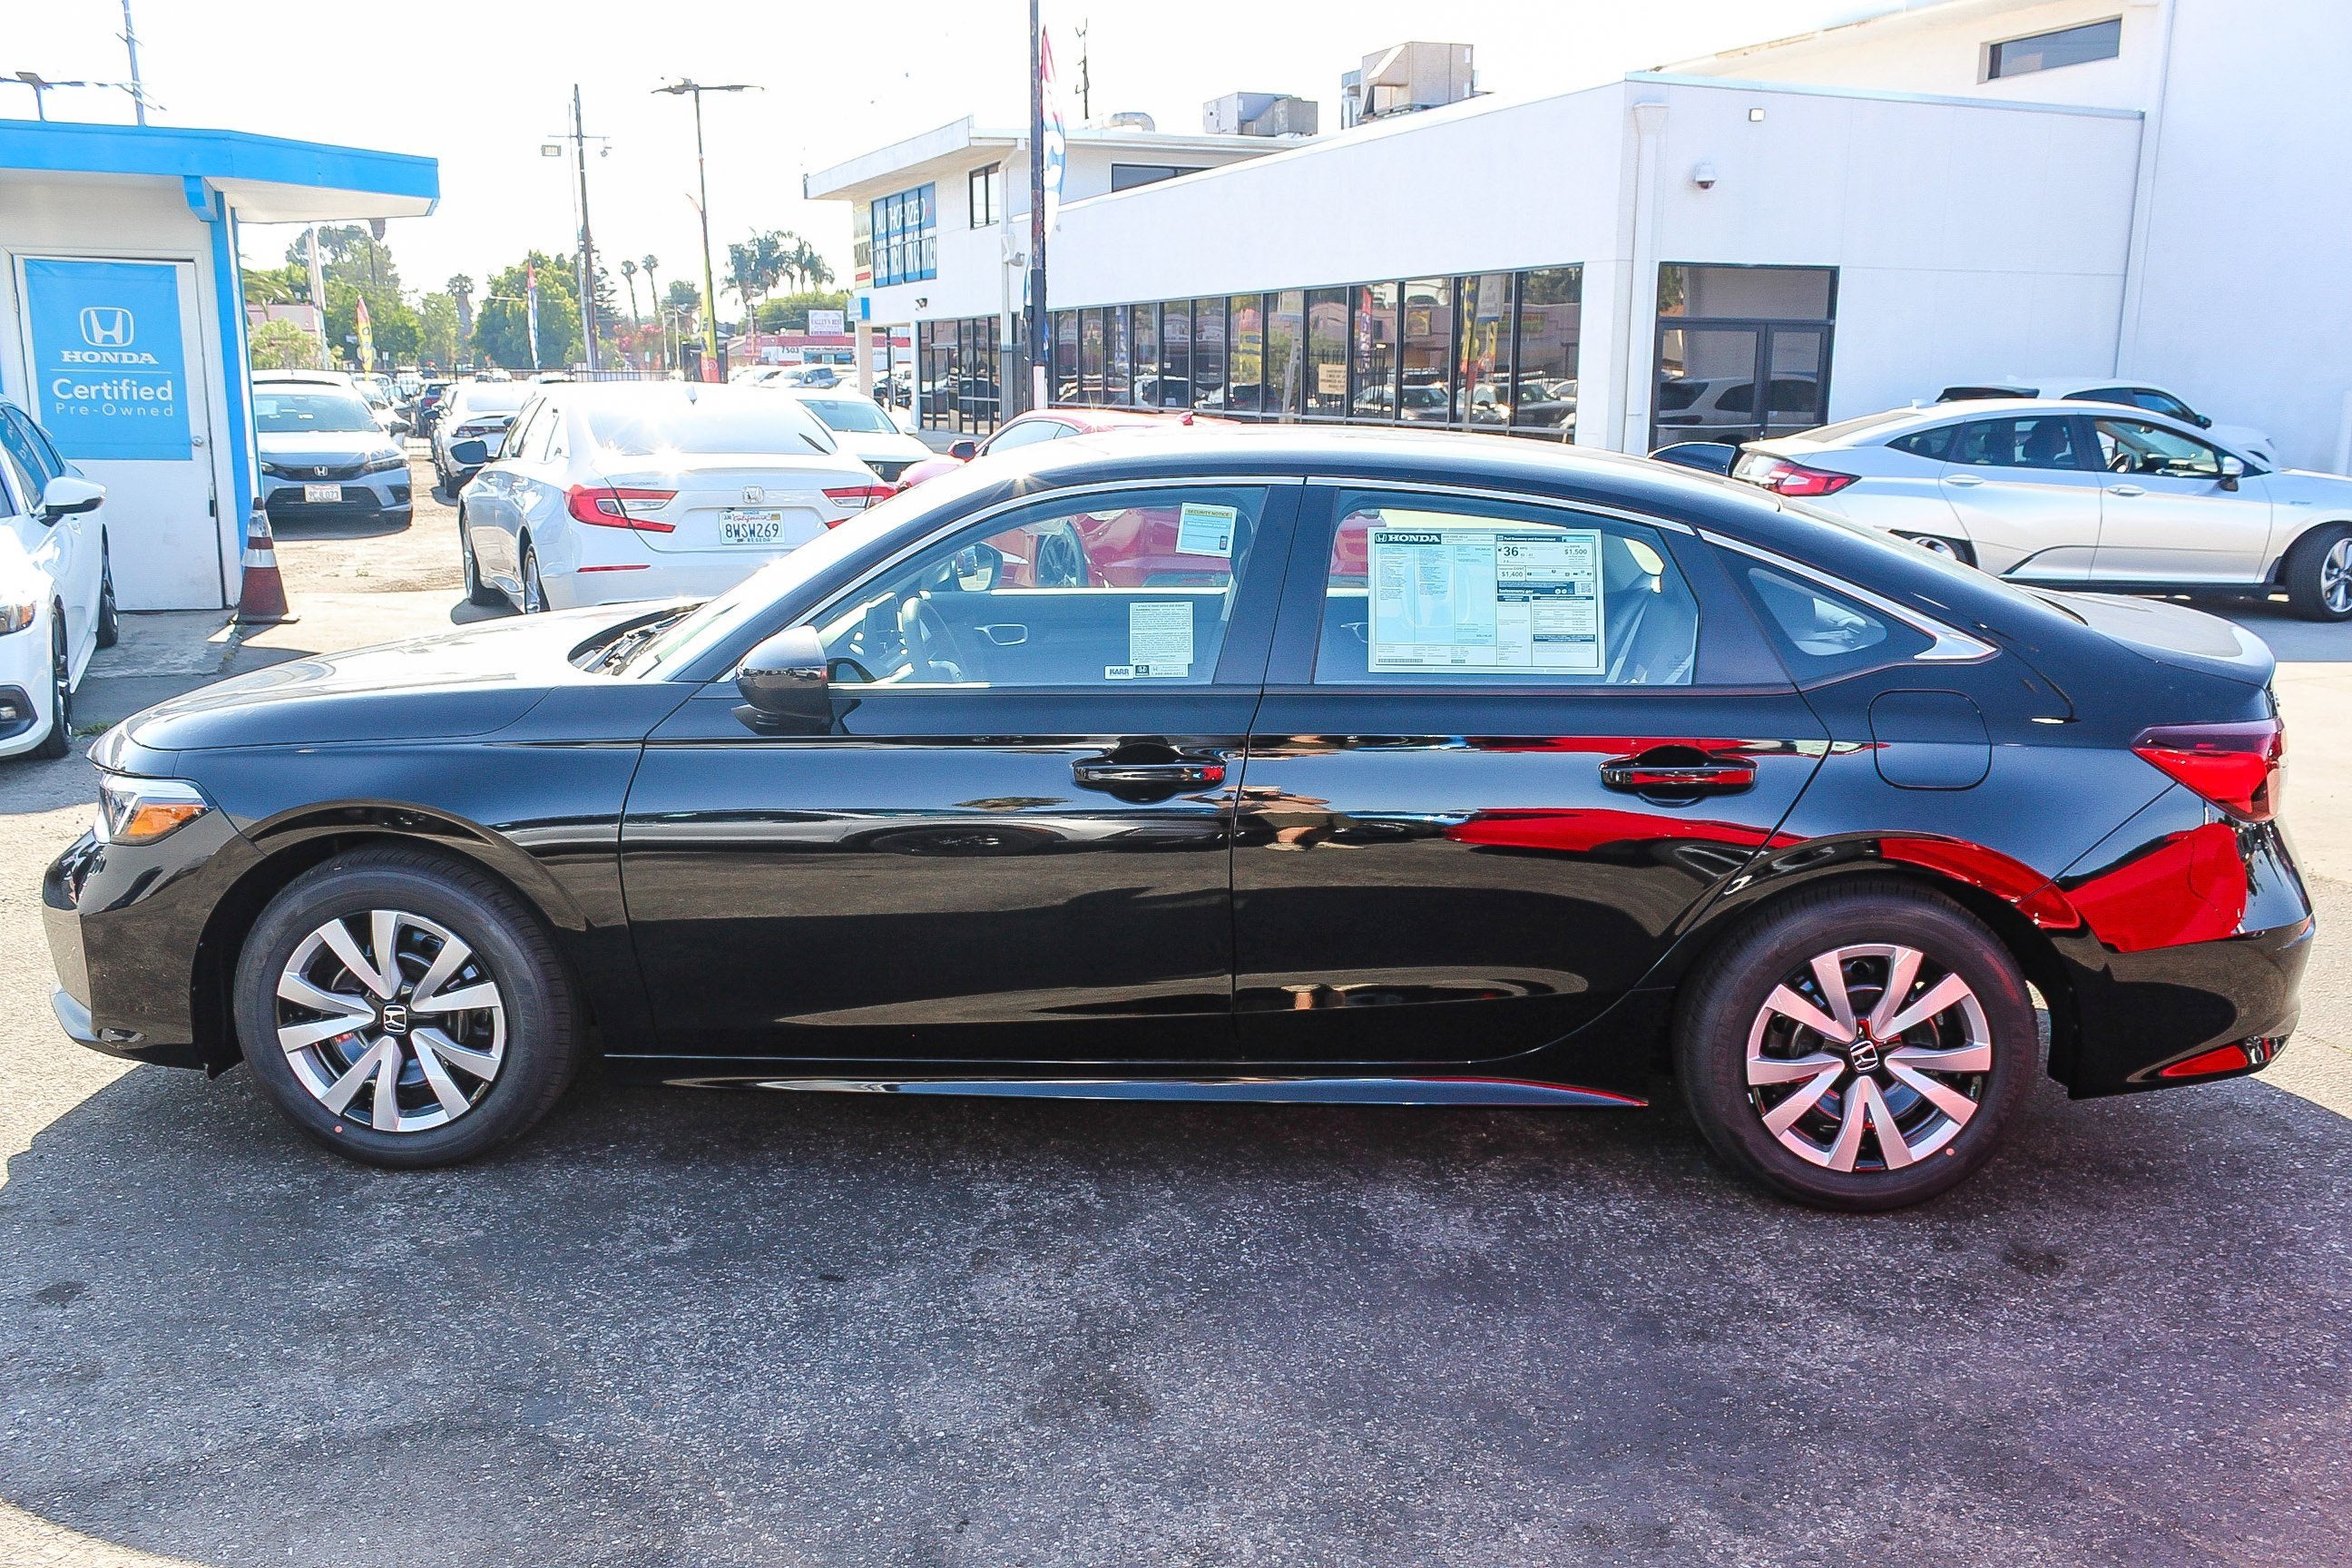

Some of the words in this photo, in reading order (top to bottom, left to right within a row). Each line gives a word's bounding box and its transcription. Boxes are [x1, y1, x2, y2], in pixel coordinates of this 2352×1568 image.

[61, 350, 160, 365] HONDA
[52, 377, 173, 401] Certified
[55, 402, 173, 417] Pre-Owned
[725, 523, 779, 538] 8WSW269
[1388, 534, 1441, 543] HONDA
[1503, 546, 1519, 557] 36
[1109, 668, 1130, 676] KARR
